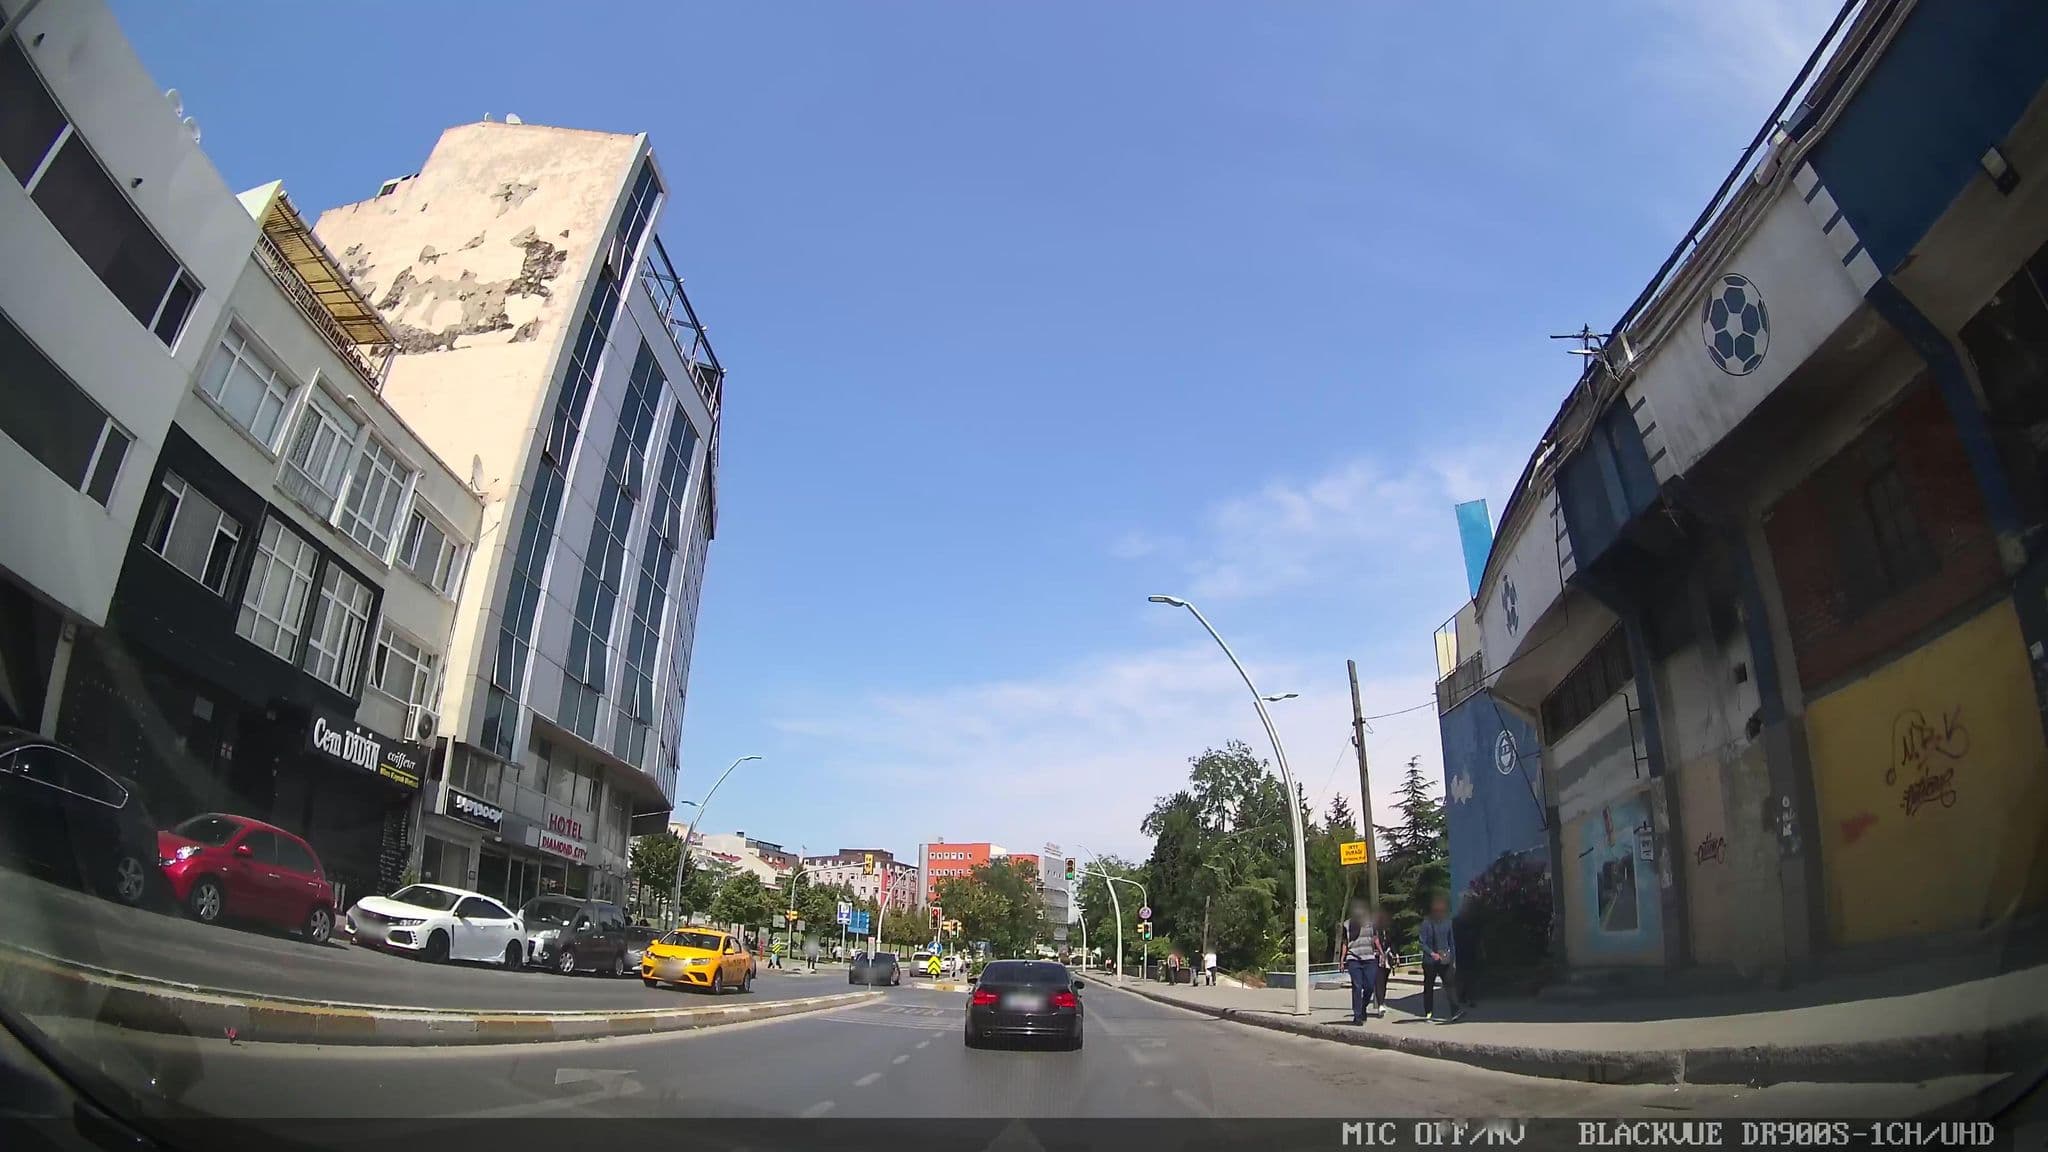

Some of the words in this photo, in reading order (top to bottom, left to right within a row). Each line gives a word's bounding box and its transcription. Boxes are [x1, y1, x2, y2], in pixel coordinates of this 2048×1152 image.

[313, 717, 342, 757] Cem
[387, 751, 416, 769] coiffeur
[546, 812, 583, 840] HOTEL
[541, 835, 573, 858] DIAMOND
[573, 846, 589, 861] CITY
